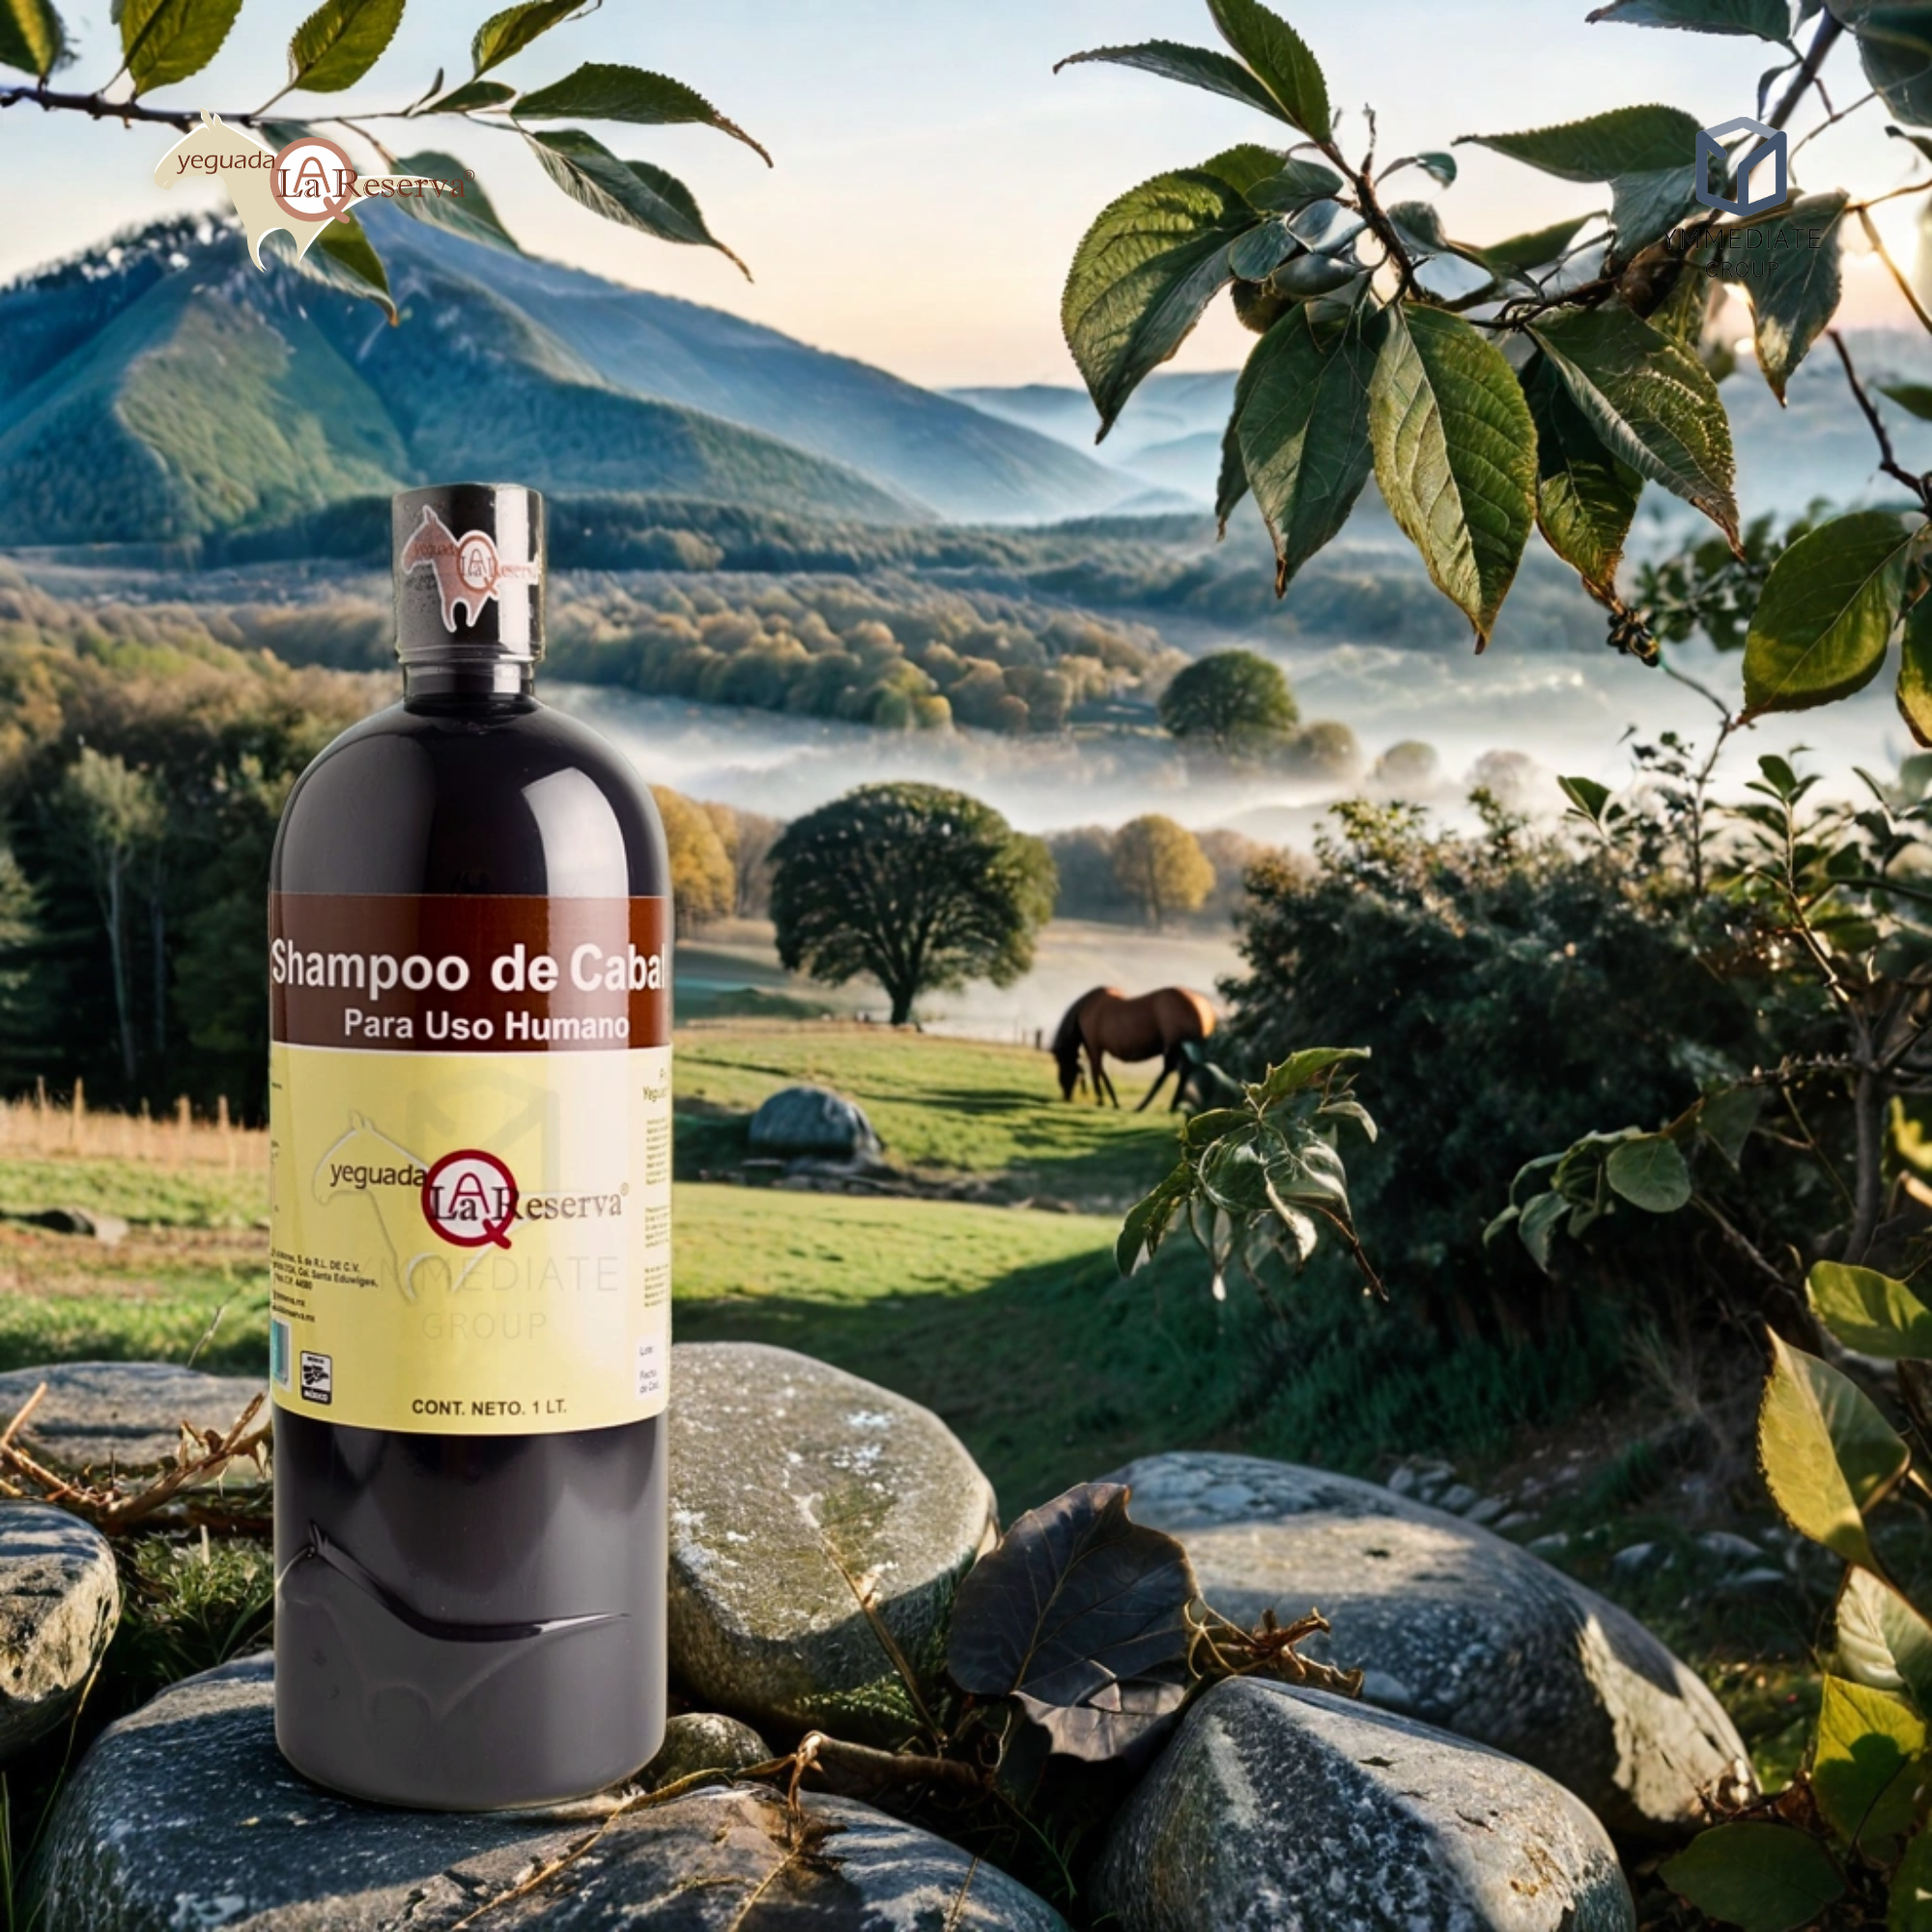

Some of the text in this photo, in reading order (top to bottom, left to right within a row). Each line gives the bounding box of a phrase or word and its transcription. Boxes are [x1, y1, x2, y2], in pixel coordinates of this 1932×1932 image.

[271, 938, 470, 1001] Shampoo
[491, 944, 557, 992] de
[344, 1008, 631, 1041] Para Uso Humano
[329, 1163, 426, 1189] yeguada
[430, 1185, 476, 1222] La
[329, 1259, 341, 1271] DE
[412, 1399, 567, 1416] CONT. NETO. 1 LT.
